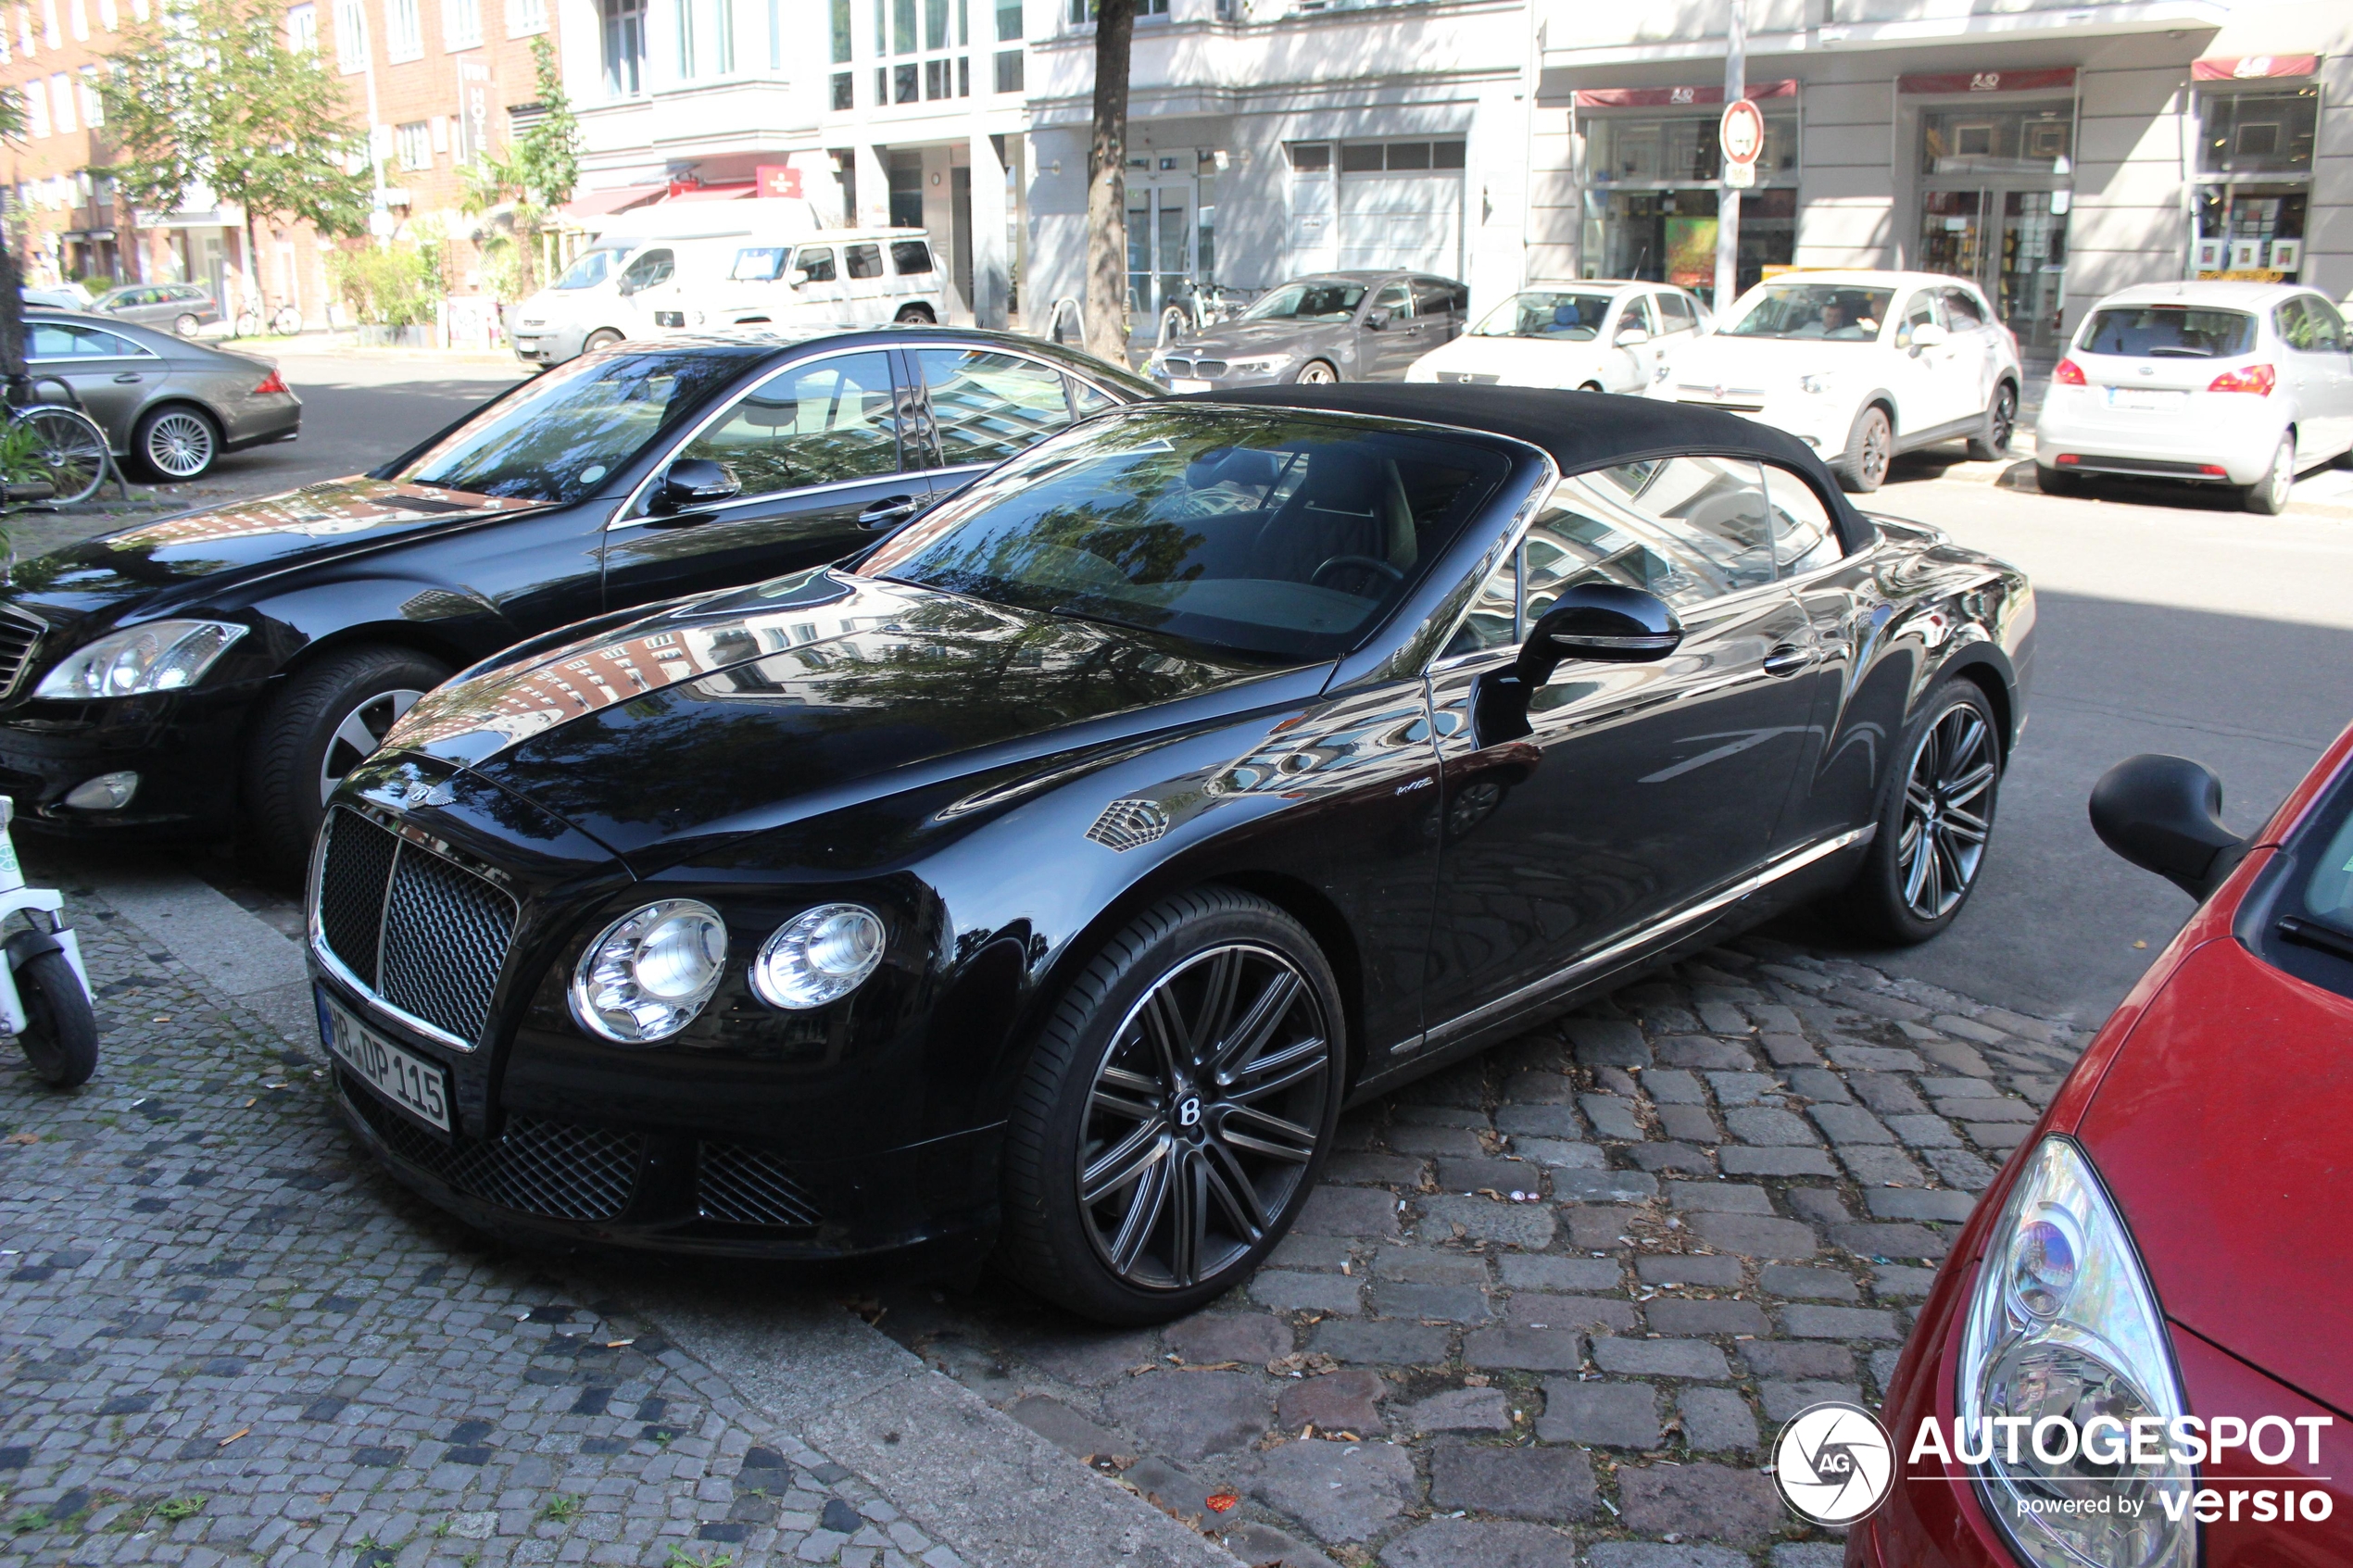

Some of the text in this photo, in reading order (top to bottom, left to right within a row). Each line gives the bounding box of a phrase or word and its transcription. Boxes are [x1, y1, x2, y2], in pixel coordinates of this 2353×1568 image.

[360, 1031, 389, 1085] DP
[393, 1055, 444, 1121] 115
[1181, 1098, 1201, 1126] B
